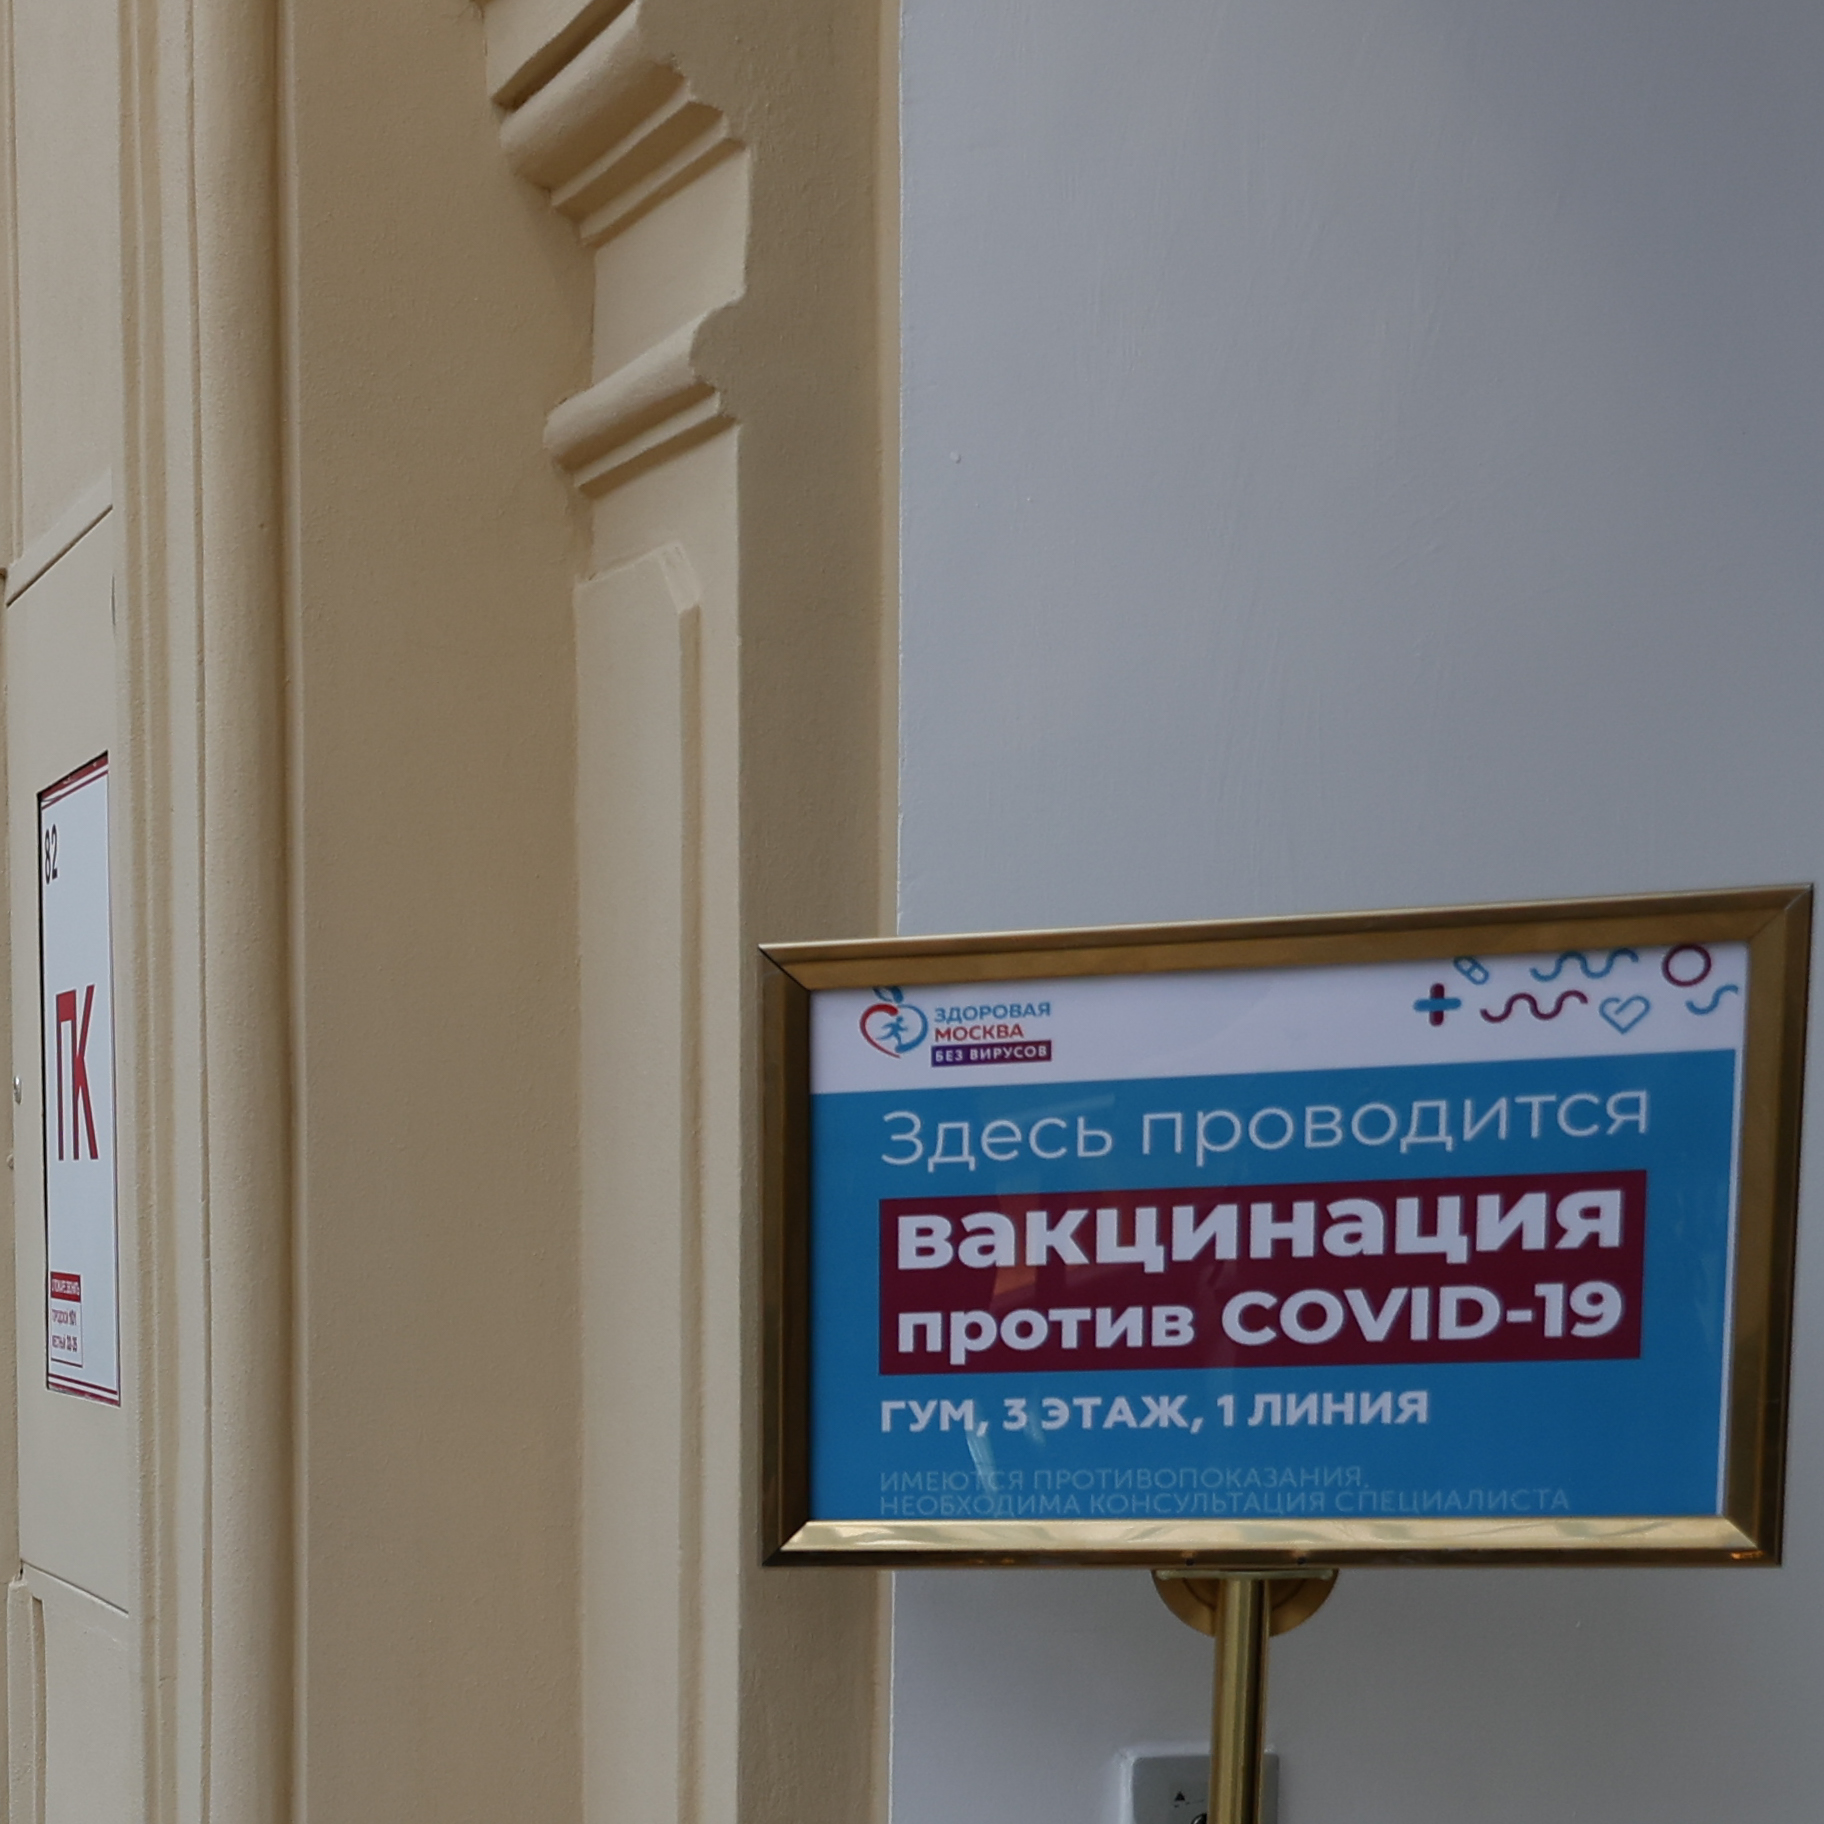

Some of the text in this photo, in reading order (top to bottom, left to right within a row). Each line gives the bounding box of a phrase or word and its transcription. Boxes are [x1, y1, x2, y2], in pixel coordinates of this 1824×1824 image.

[44, 823, 59, 885] 82
[934, 1002, 1052, 1024] ЗДОРОВАЯ
[935, 1023, 1025, 1042] МОСКВА
[55, 984, 100, 1162] ПК
[935, 1044, 1048, 1063] БЕЗ ВИРУСОВ
[881, 1089, 1649, 1173] Здесь проводится
[897, 1188, 1624, 1274] вакцинация
[897, 1280, 1623, 1366] против COVID-19
[880, 1391, 1429, 1437] ГУМ, 3 ЭТАЖ, 1 ЛИНИЯ
[880, 1465, 1370, 1492] ИМЕЮТСЯ ПРОТИВОПОКАЗАНИЯ.
[880, 1488, 1570, 1518] НЕОБХОДИМА КОНСУЛЬТАЦИЯ СПЕЦИАЛИСТА
